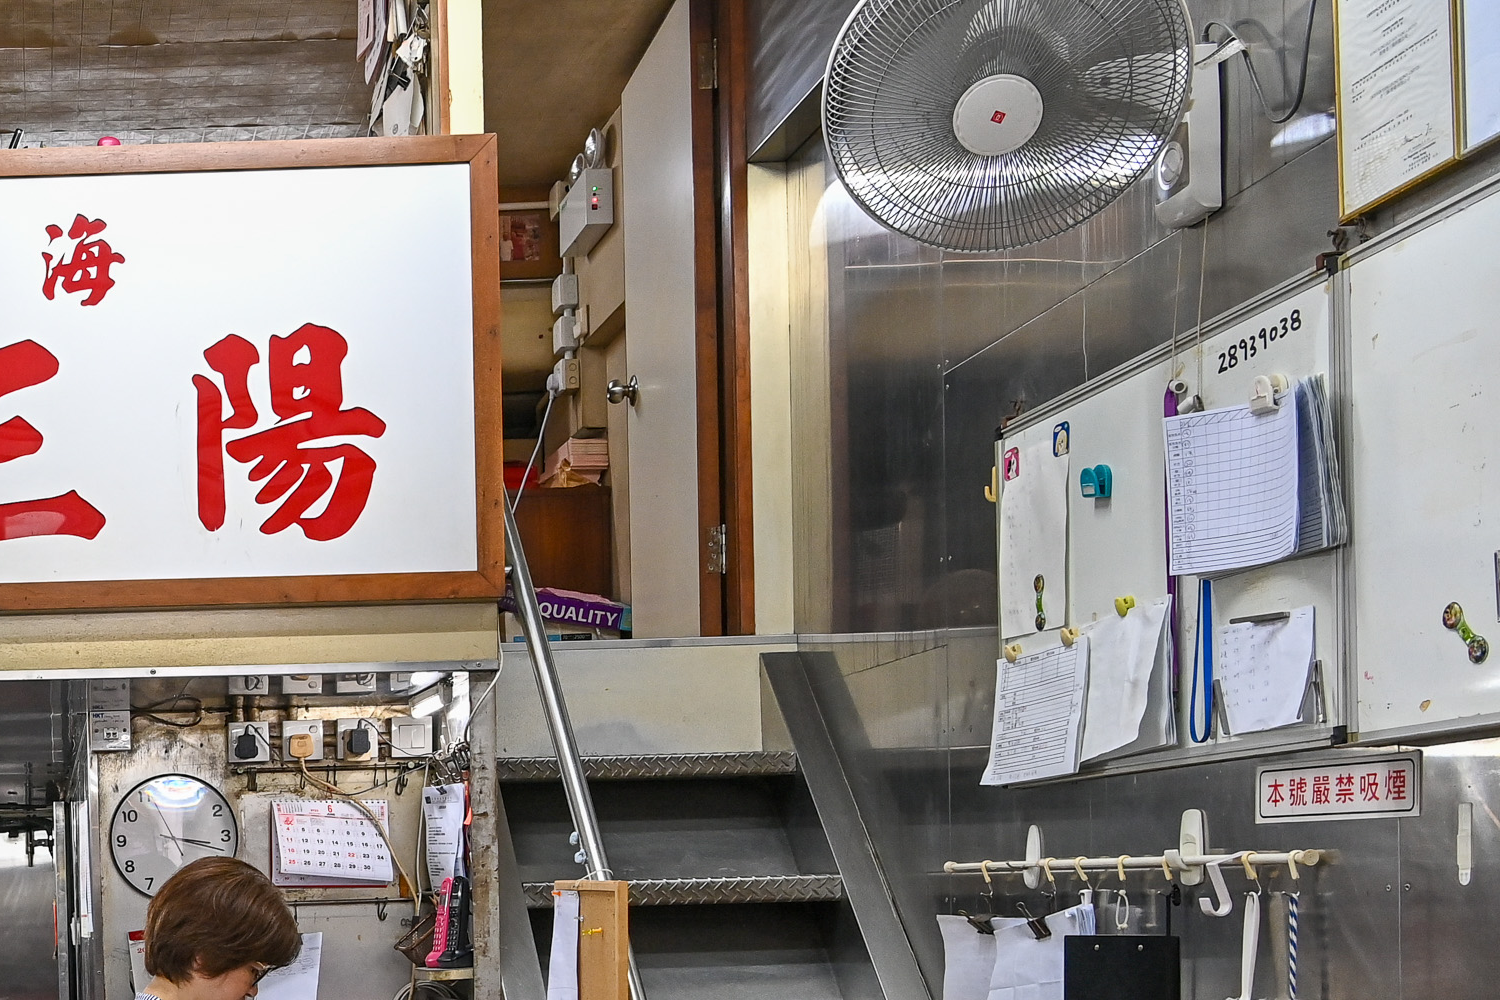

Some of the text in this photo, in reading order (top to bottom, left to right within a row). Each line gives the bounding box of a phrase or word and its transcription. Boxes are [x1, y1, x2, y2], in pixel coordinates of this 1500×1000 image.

[1217, 309, 1303, 375] 28939038
[539, 602, 618, 626] QUALITY
[1266, 769, 1409, 807] 本號嚴禁吸煙
[212, 804, 223, 817] 2
[327, 804, 333, 813] 6
[122, 809, 138, 823] 10
[116, 834, 127, 848] 9
[220, 829, 231, 842] 3
[125, 860, 135, 873] 8
[144, 877, 154, 891] 7
